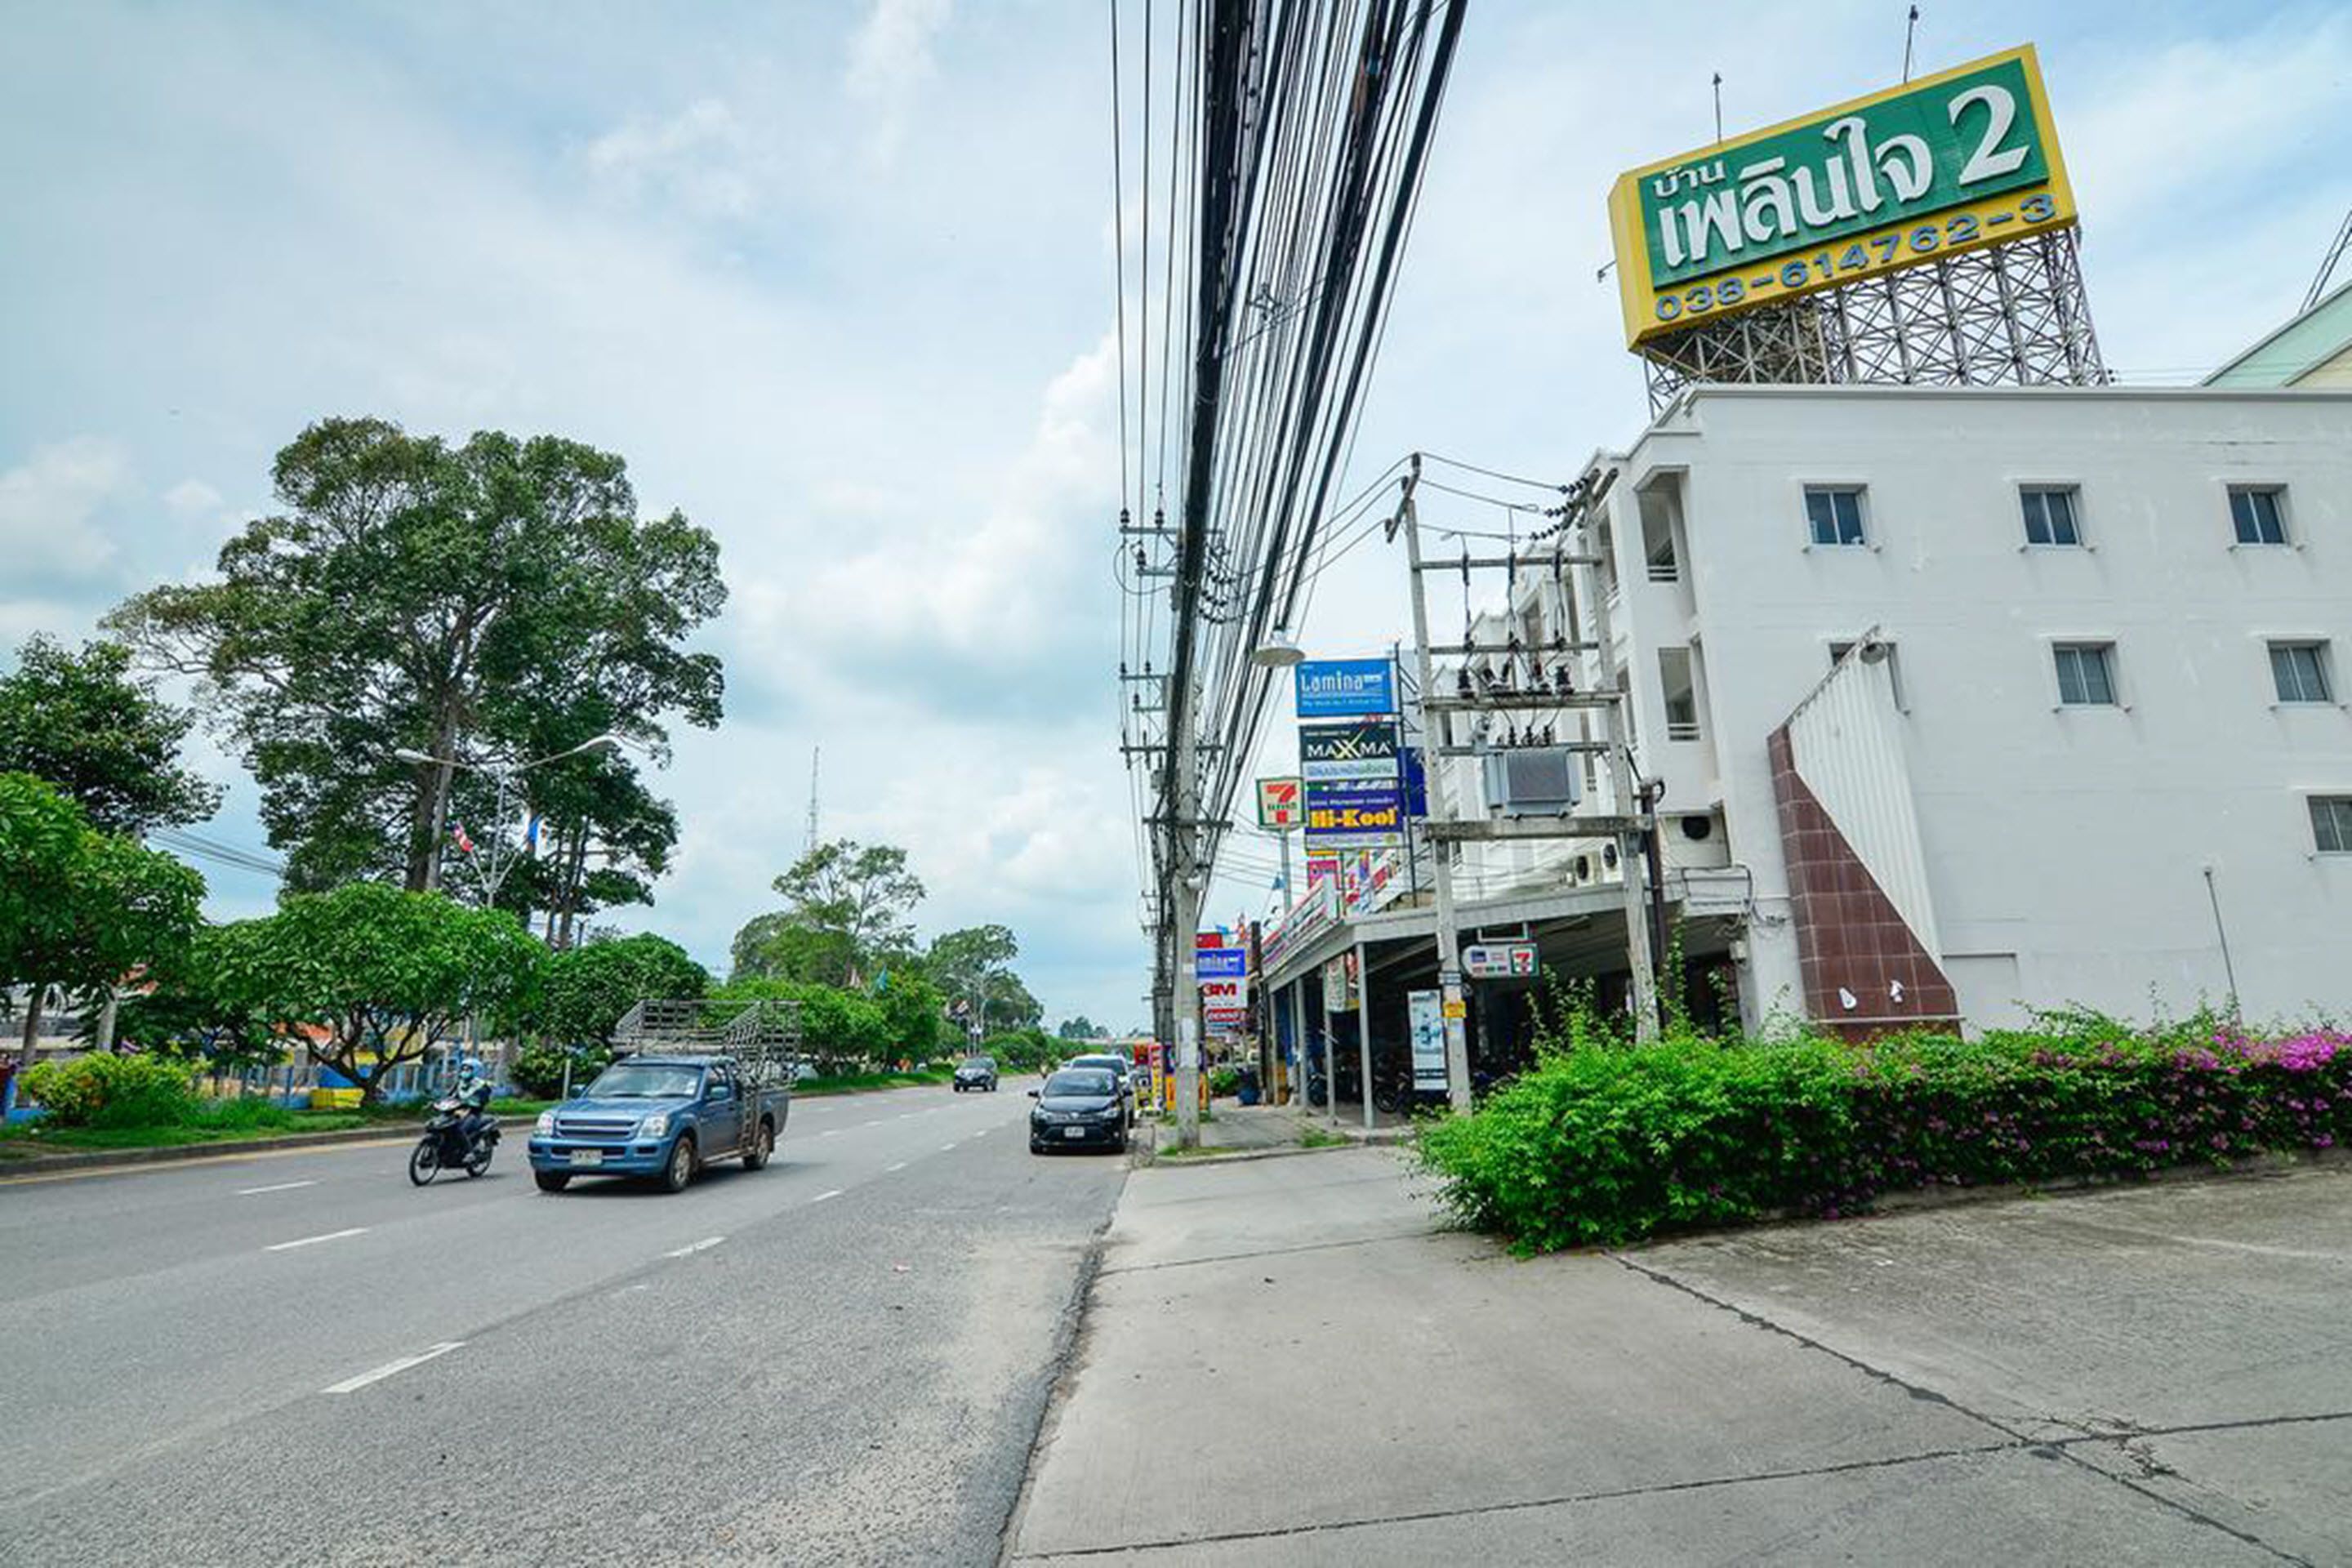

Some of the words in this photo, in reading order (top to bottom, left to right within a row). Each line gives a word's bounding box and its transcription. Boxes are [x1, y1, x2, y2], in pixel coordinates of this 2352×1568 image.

[1653, 160, 1726, 197] บ้าน
[1658, 116, 1934, 270] เพลินใจ
[1947, 84, 2031, 185] 2
[1655, 193, 2058, 321] 038-614762-3
[1301, 670, 1363, 693] Lamina
[1266, 783, 1297, 824] 7
[1311, 808, 1397, 829] Hi-Kool
[1204, 982, 1237, 996] 3M
